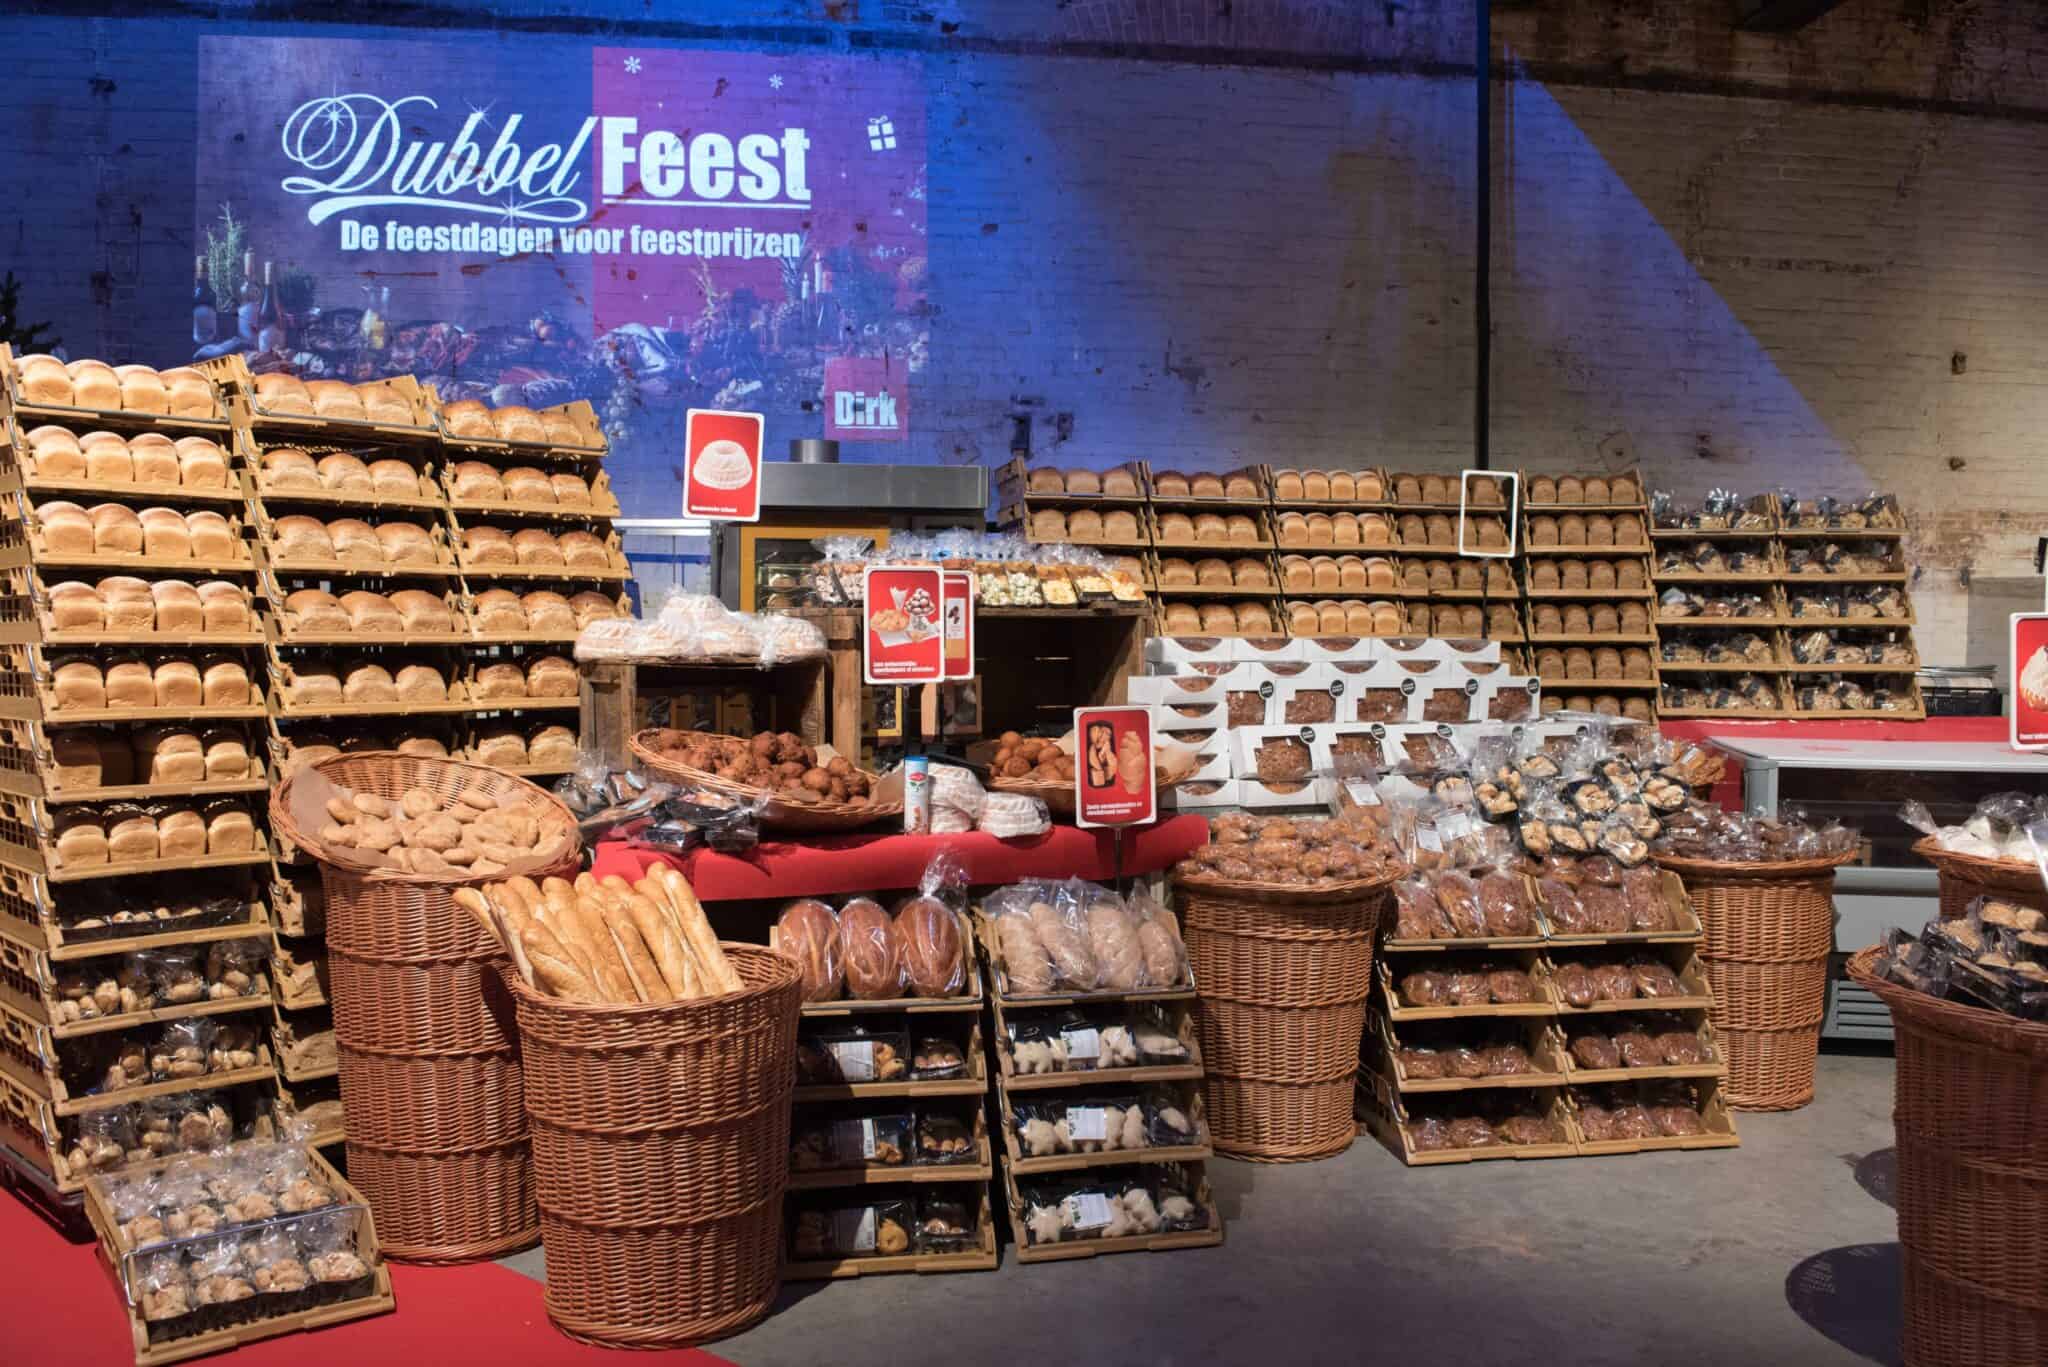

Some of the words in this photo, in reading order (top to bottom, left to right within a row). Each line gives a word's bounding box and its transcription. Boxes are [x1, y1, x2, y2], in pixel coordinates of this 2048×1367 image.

[281, 94, 598, 197] Dubbel
[602, 117, 811, 201] Feest
[341, 220, 379, 251] De
[385, 221, 553, 257] feestdagen
[559, 226, 624, 254] voor
[630, 225, 801, 259] feestprijzen
[835, 391, 898, 426] Dirk
